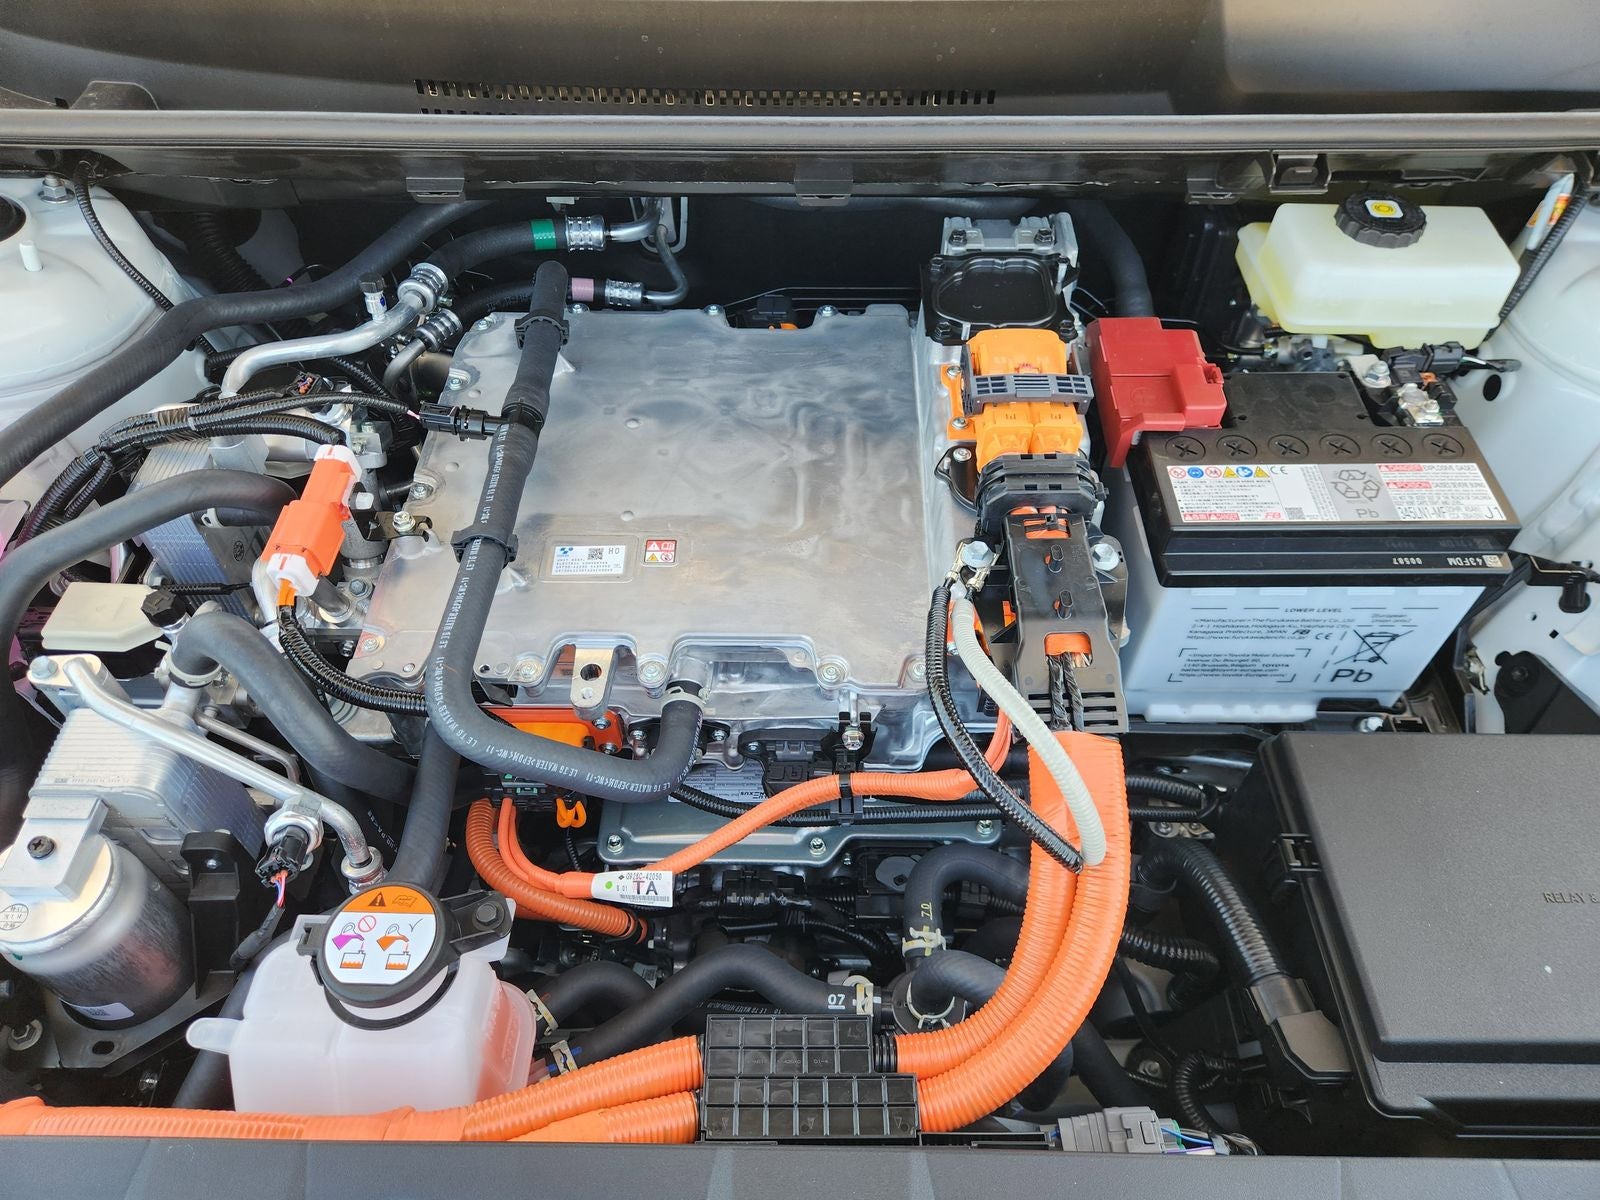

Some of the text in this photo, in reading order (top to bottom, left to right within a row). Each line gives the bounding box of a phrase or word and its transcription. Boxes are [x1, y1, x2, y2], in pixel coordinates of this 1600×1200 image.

[435, 656, 445, 676] WC-11
[1330, 669, 1373, 683] Pb
[438, 704, 459, 732] WATER
[456, 729, 468, 740] TG
[466, 736, 478, 747] LE
[486, 745, 509, 759] WC-11
[535, 760, 558, 772] WATER
[569, 768, 578, 777] LE
[586, 772, 606, 785] WC-11
[629, 782, 652, 793] WATER
[653, 784, 661, 793] TG
[663, 782, 671, 791] LE
[632, 880, 658, 895] TA
[1542, 892, 1585, 904] RELAY
[827, 993, 846, 1005] 07
